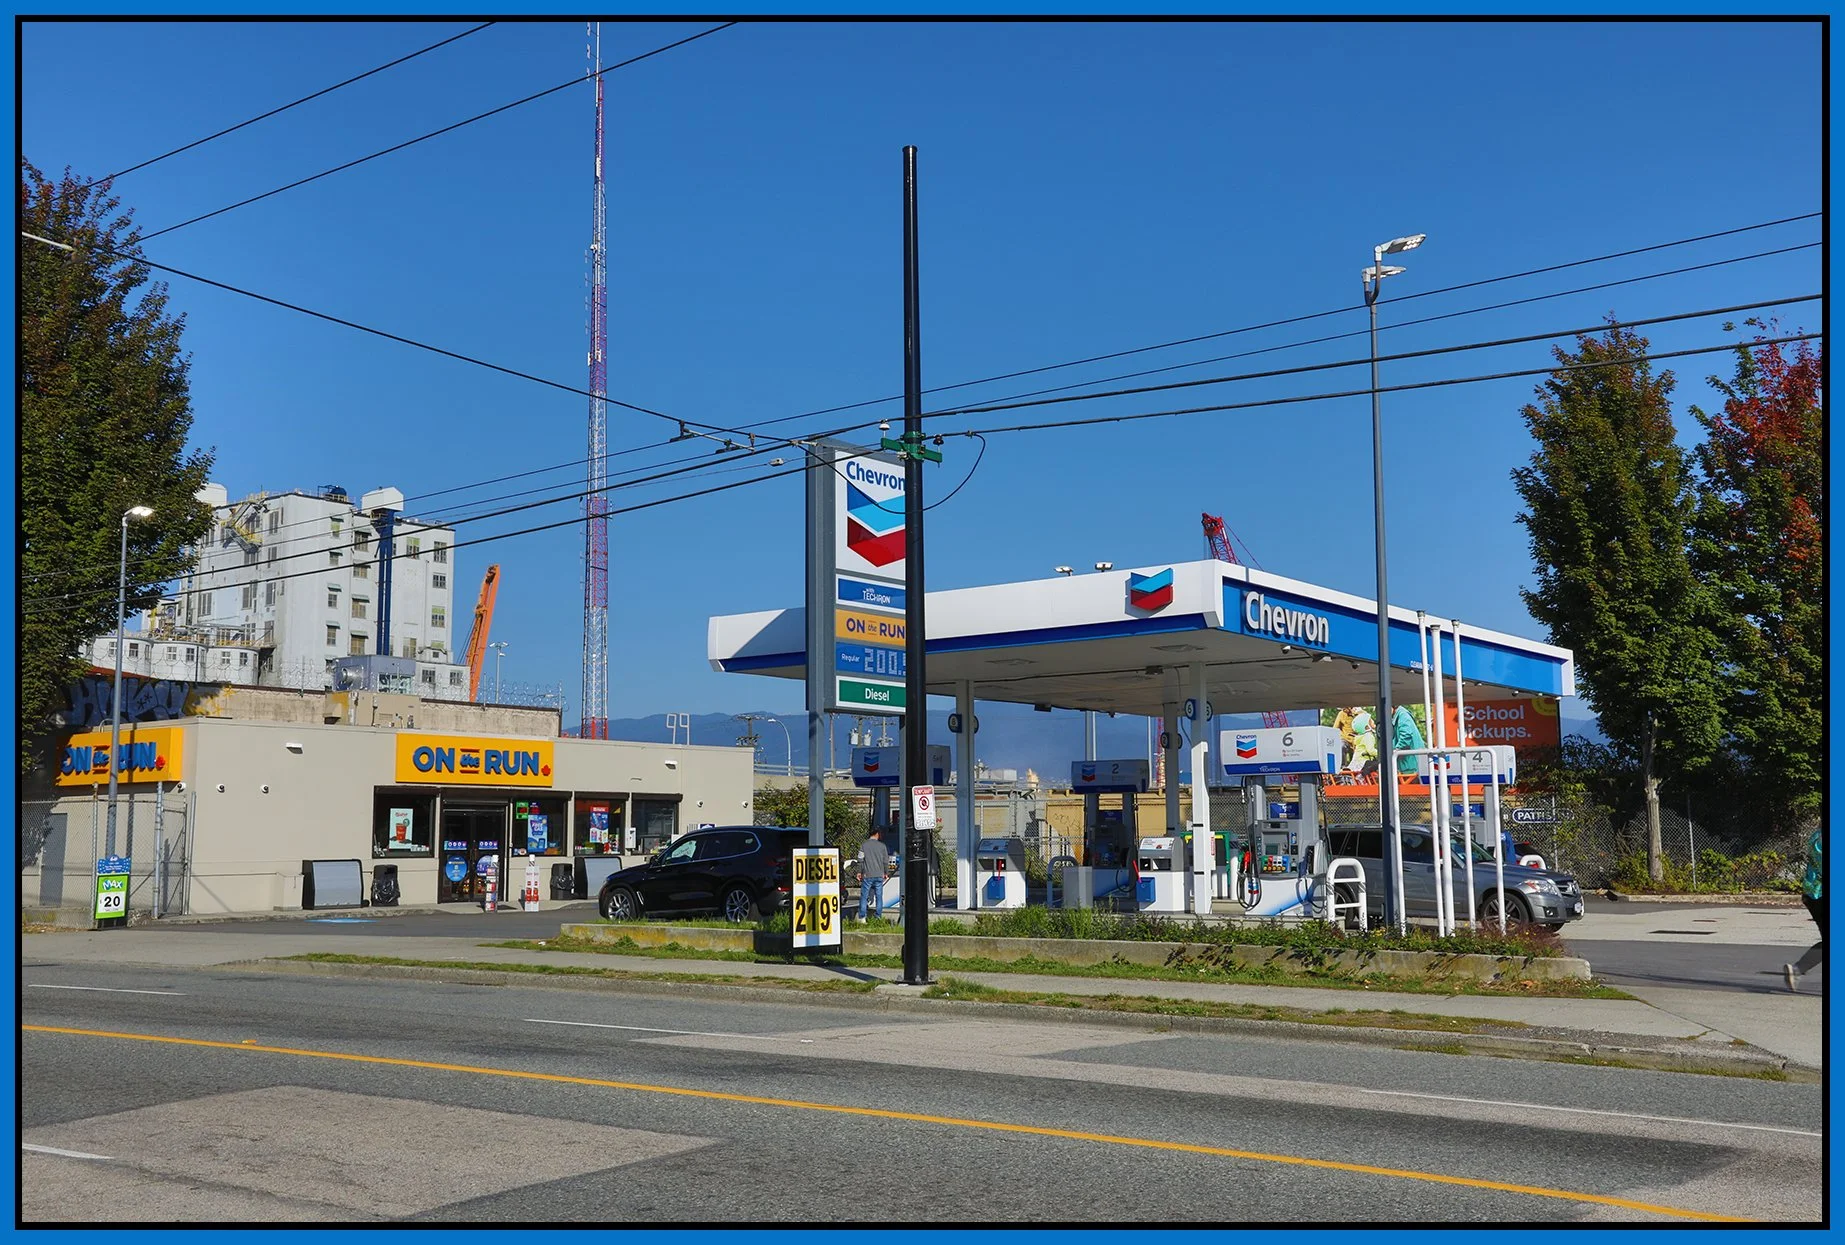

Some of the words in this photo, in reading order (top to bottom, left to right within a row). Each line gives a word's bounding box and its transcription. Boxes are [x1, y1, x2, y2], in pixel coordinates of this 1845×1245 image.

[846, 461, 906, 491] Chevron
[863, 591, 891, 605] TECHRON
[1245, 591, 1330, 644] Chevron
[846, 618, 866, 634] ON
[868, 624, 878, 633] the
[879, 623, 906, 639] RUN
[841, 653, 860, 663] Regular
[865, 687, 890, 702] Diesel
[1463, 704, 1525, 721] School
[1282, 732, 1294, 747] 6
[413, 745, 456, 774] ON
[460, 753, 481, 768] the
[485, 749, 540, 776] RUN
[1472, 751, 1483, 763] 4
[1111, 763, 1119, 774] 2
[795, 858, 837, 881] DIESEL
[102, 879, 123, 891] MAX
[104, 895, 121, 908] 20
